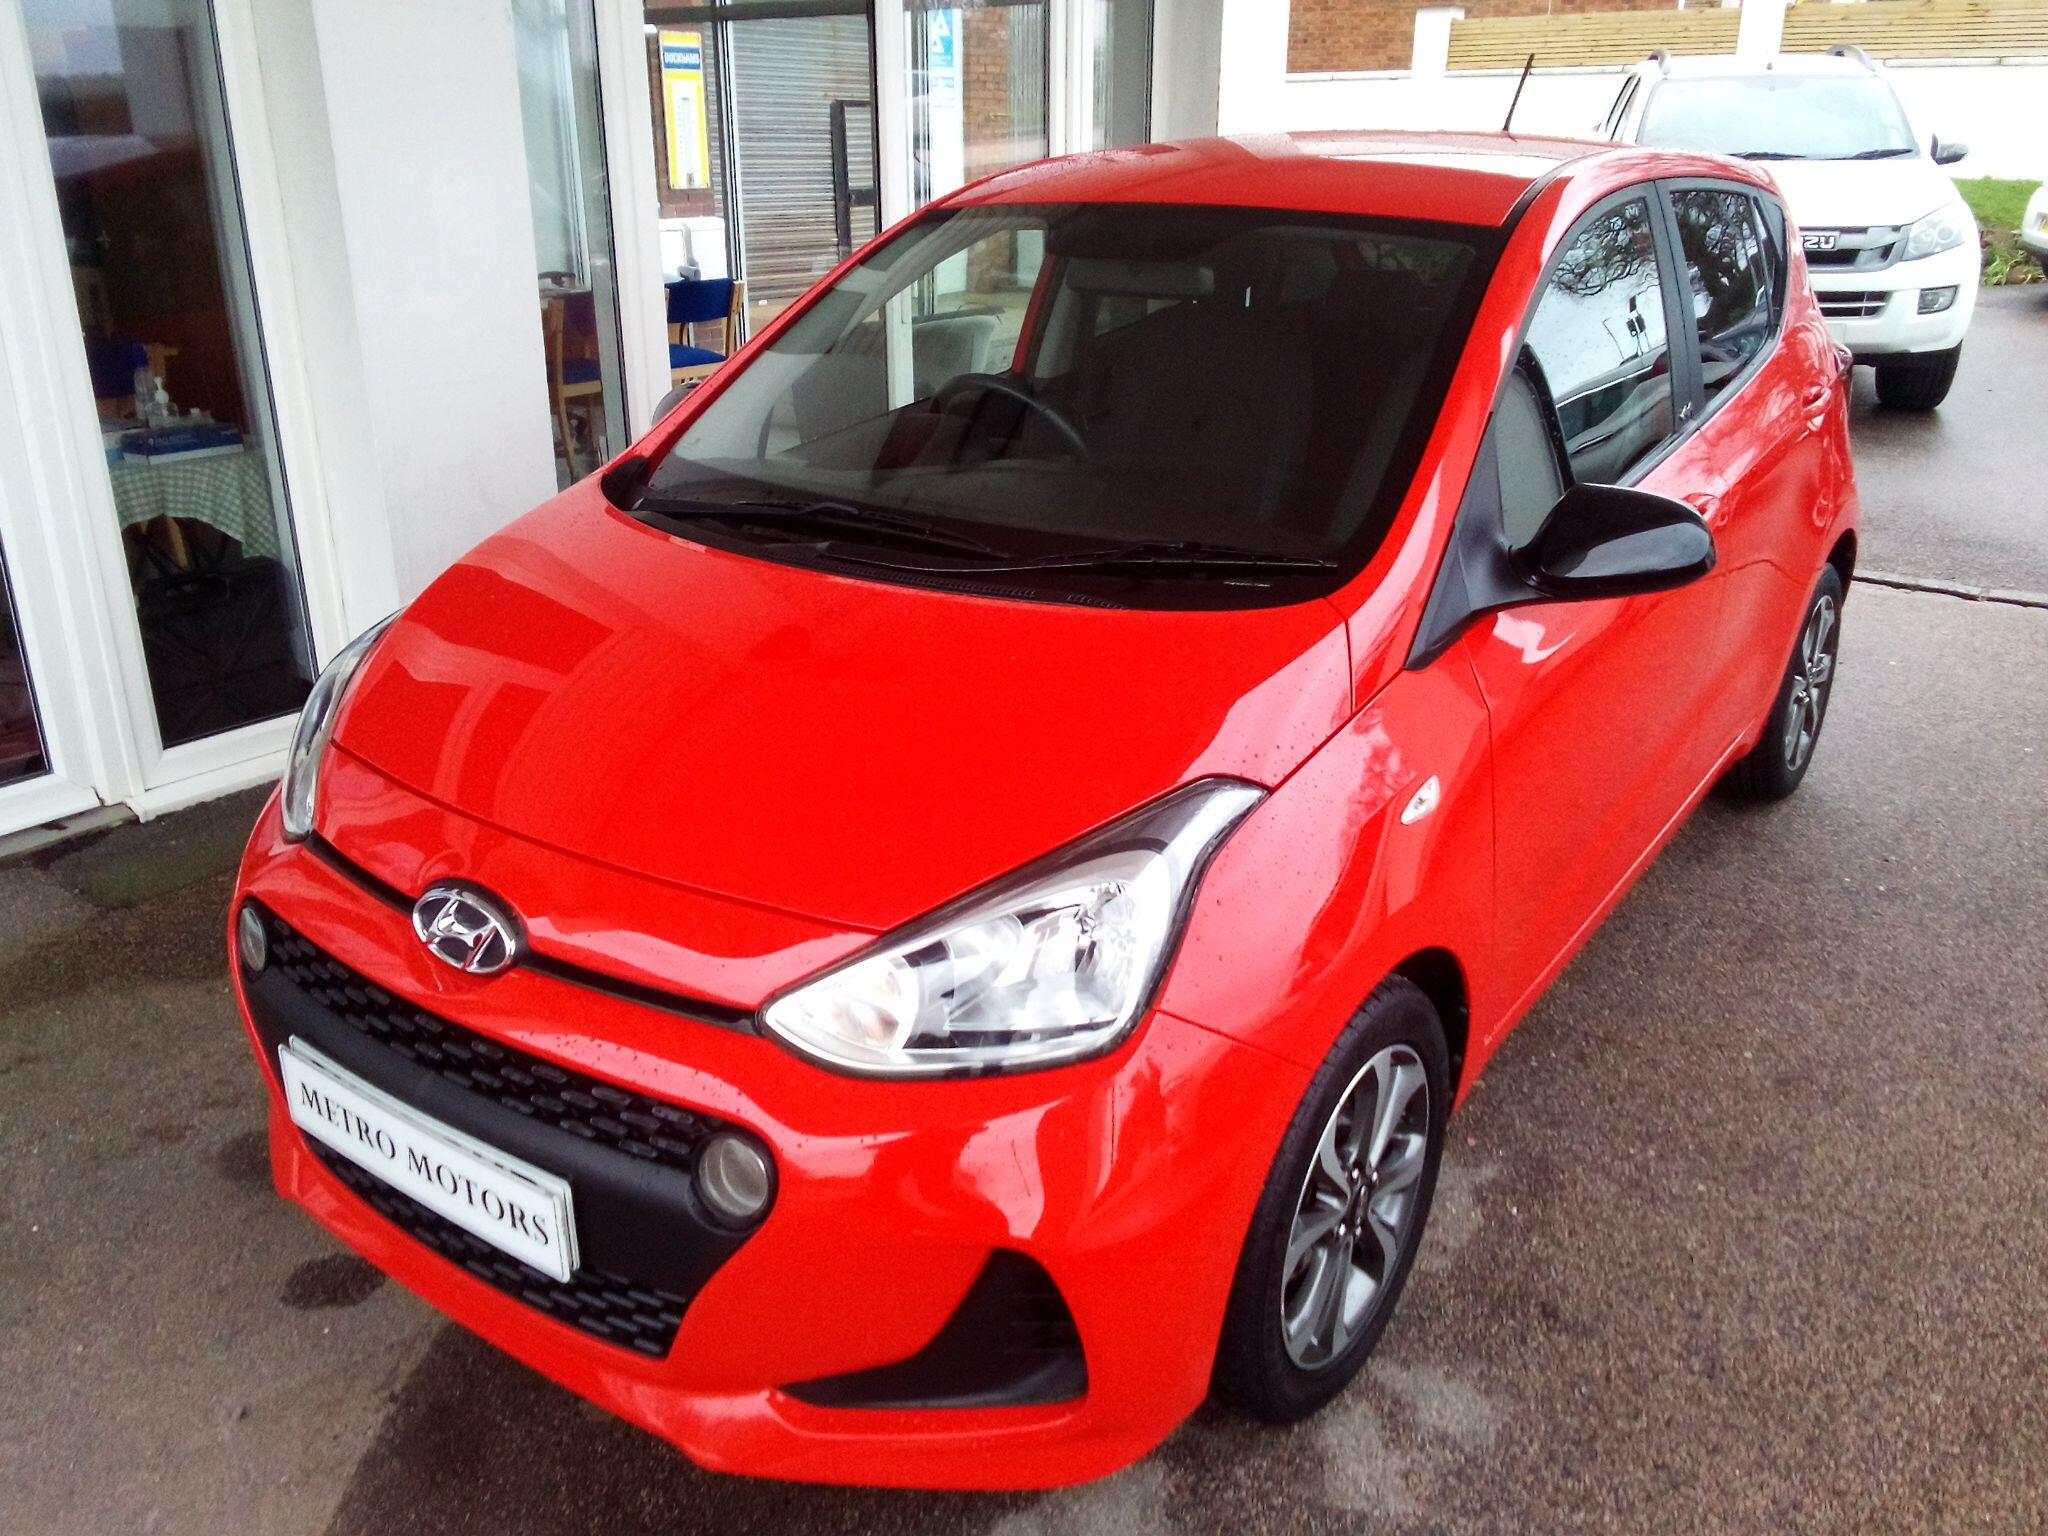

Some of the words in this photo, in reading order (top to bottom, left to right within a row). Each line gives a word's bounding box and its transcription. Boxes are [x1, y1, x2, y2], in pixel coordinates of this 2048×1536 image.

[1800, 235, 1836, 249] ZU
[301, 1082, 396, 1159] METRO
[408, 1147, 549, 1245] MOTORS
